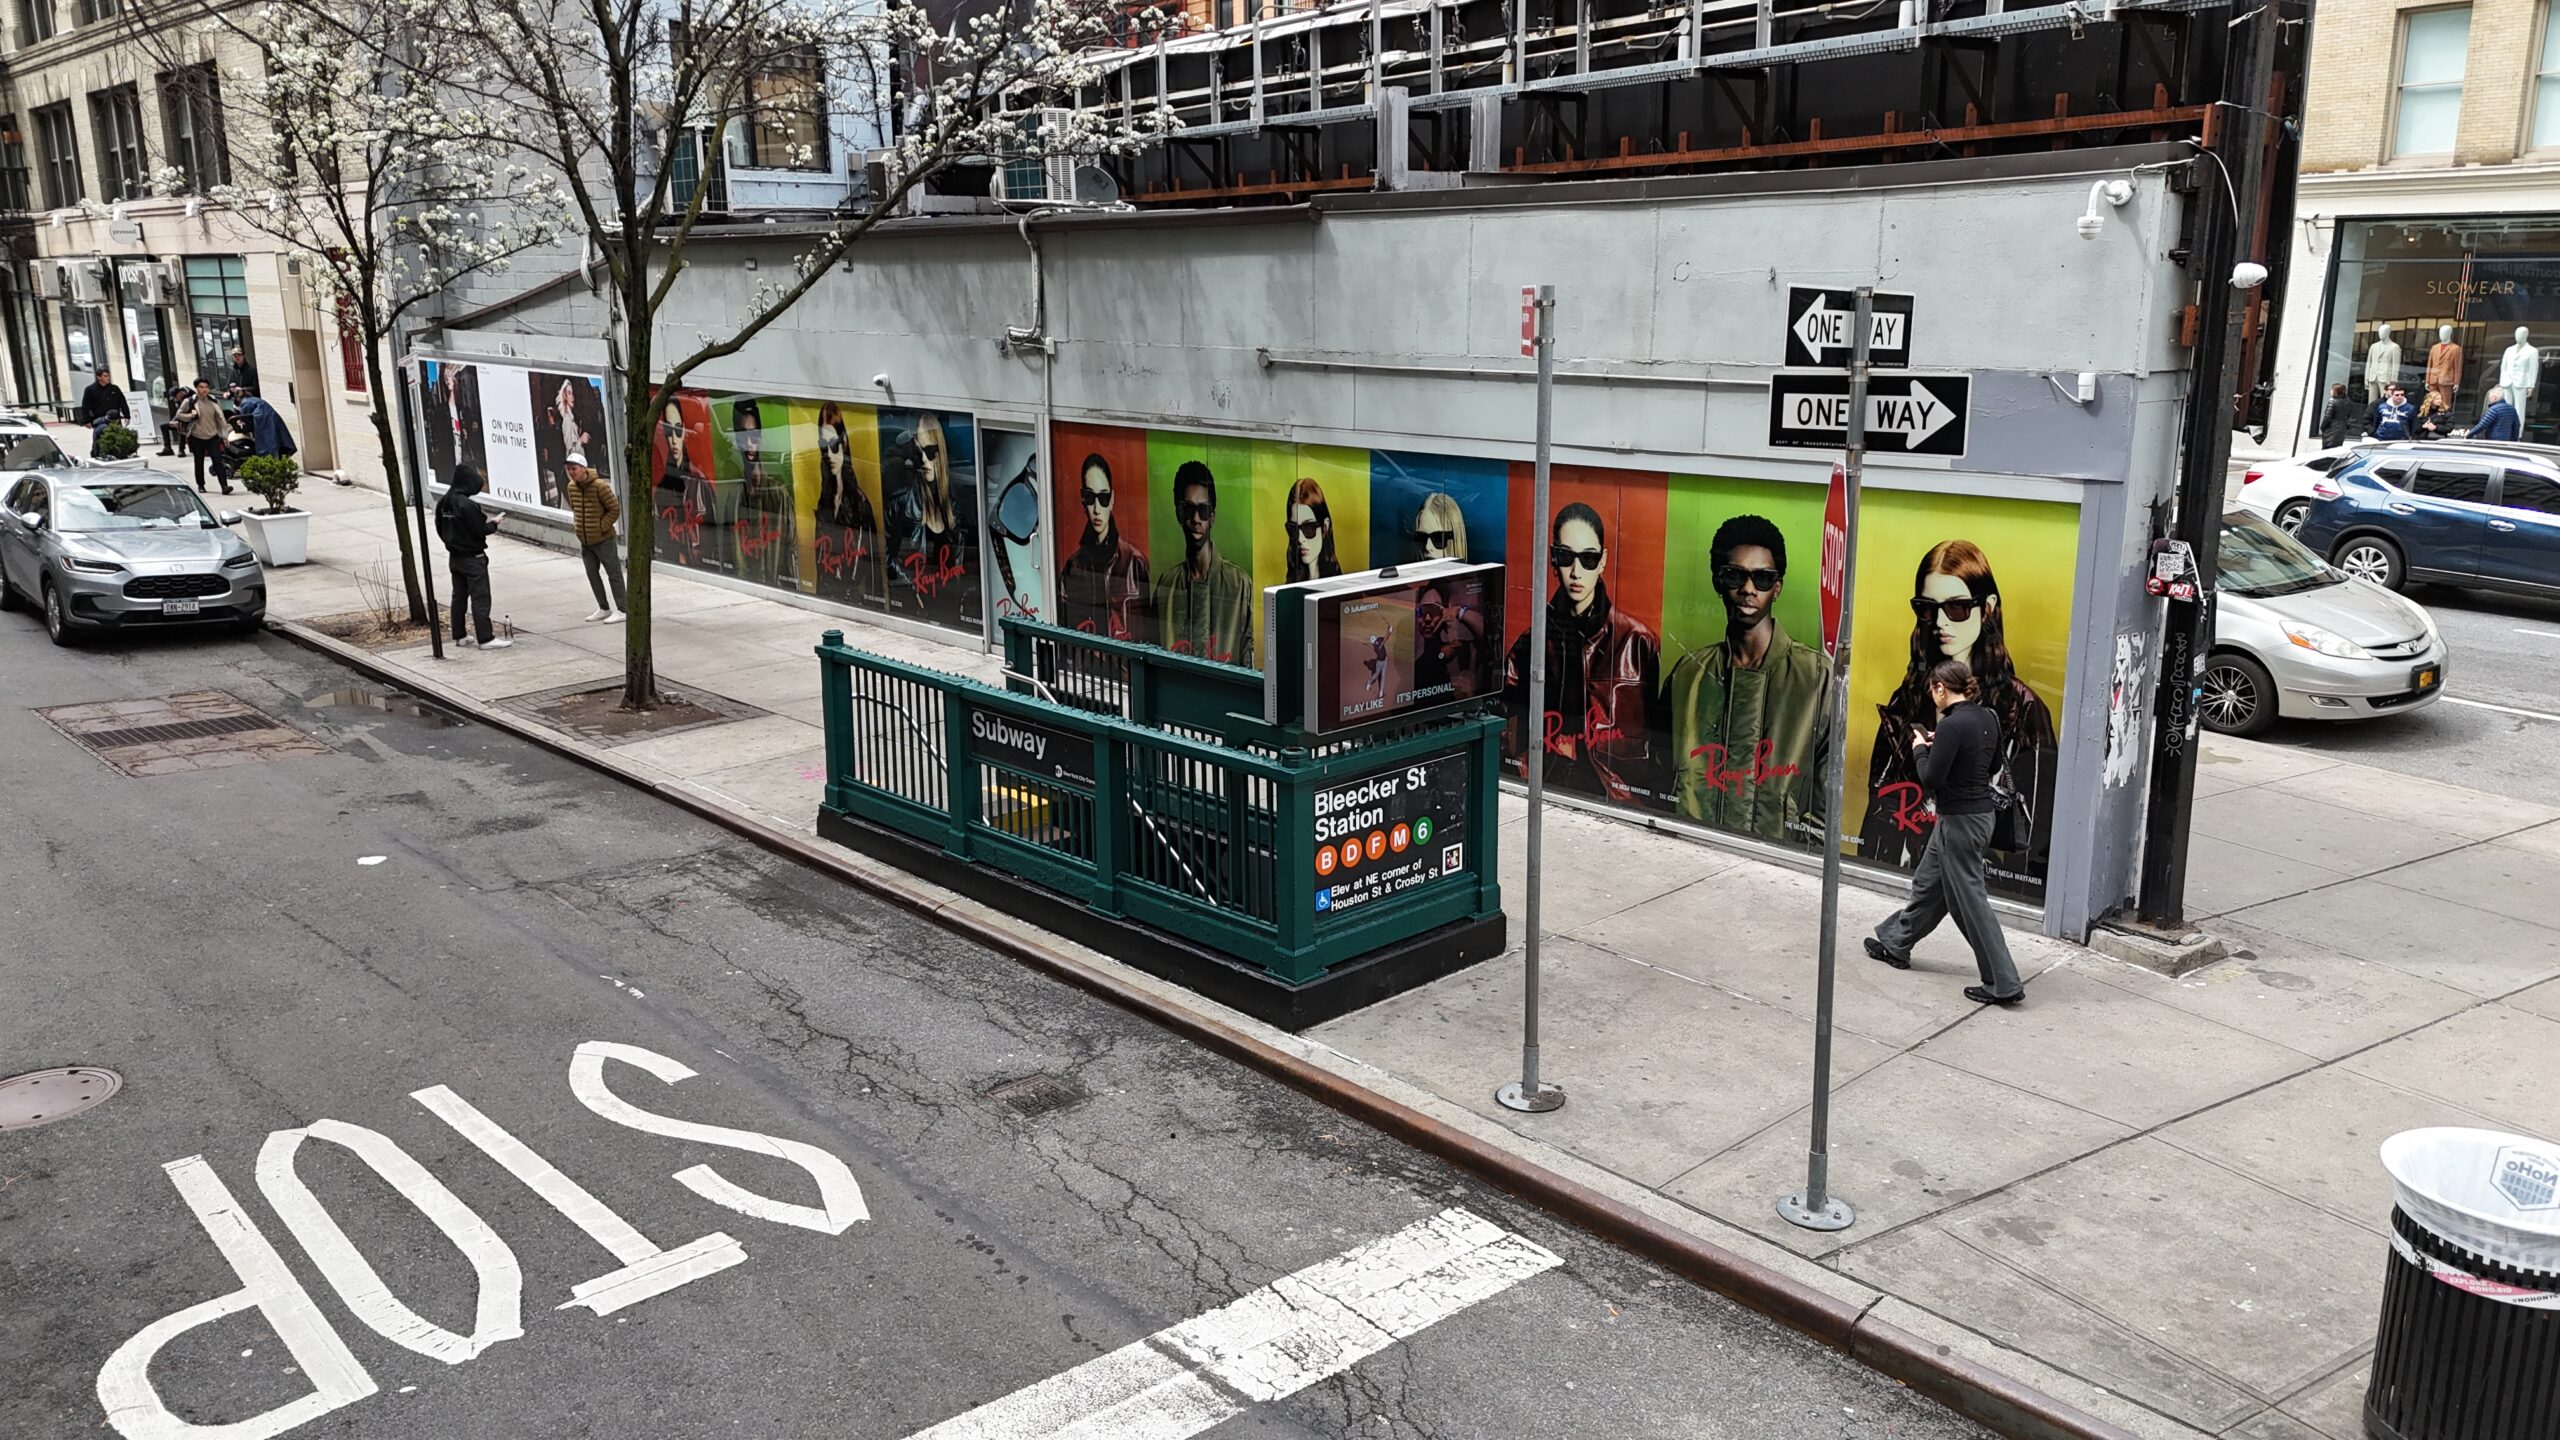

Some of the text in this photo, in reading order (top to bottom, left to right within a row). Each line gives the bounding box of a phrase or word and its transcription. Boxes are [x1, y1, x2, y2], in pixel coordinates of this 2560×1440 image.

[2426, 280, 2515, 295] SLOWEAR
[1807, 313, 1897, 346] ONE AY
[492, 419, 524, 433] ON YOUR
[1797, 397, 1936, 430] ONE WAY
[491, 433, 528, 449] OWN TIME
[497, 487, 533, 504] COACH
[1822, 521, 1844, 599] STOP
[1350, 602, 1379, 613] lululemon
[1343, 704, 1364, 716] PLAY
[1366, 698, 1384, 711] LIKE
[1396, 693, 1412, 704] IT'S
[972, 711, 1047, 760] Subway
[1314, 766, 1427, 817] Bleecker St
[1315, 807, 1384, 842] Station
[1321, 822, 1428, 870] B D F M 6
[1331, 858, 1422, 897] Elev at NE corner of
[1331, 867, 1438, 912] Houston St & Crosby St
[97, 1040, 871, 1440] STOP
[2469, 1285, 2513, 1294] NOHO.BID
